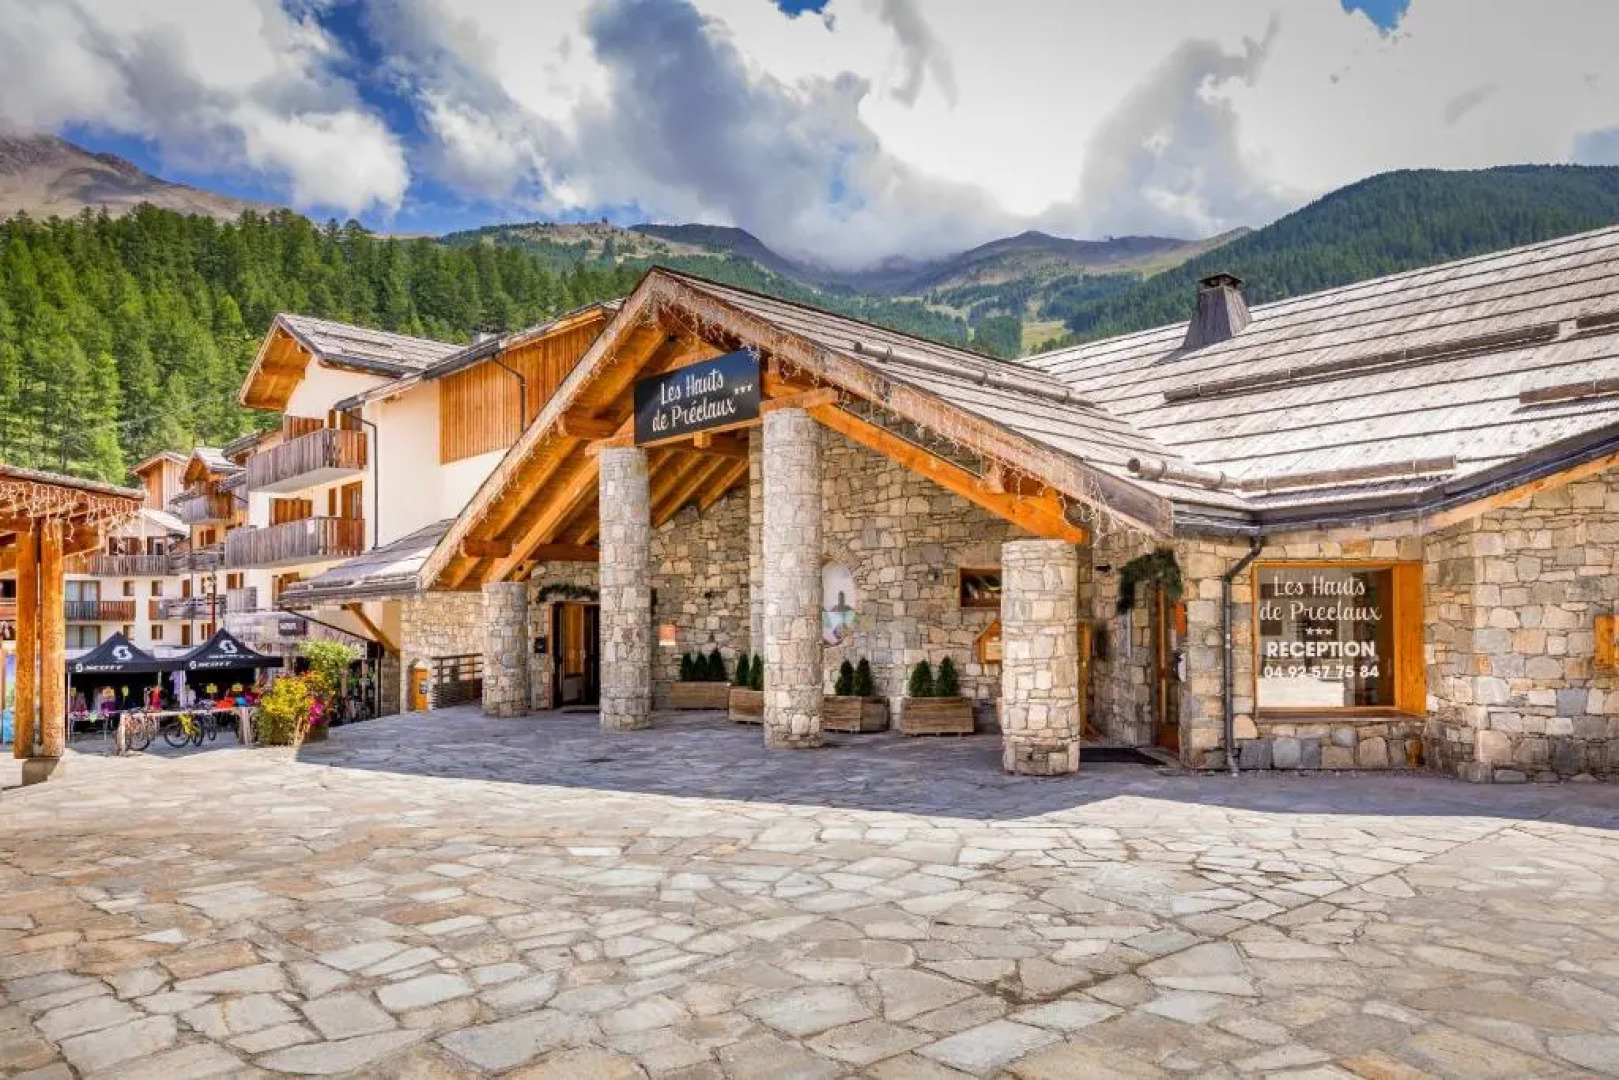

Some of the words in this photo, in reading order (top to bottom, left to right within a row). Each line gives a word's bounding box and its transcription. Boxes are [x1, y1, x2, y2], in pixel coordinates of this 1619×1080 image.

[661, 382, 681, 406] Les
[685, 368, 724, 398] Hauts
[652, 408, 669, 432] de
[1273, 575, 1304, 597] Les
[1312, 575, 1366, 596] Hauts
[1259, 600, 1284, 621] de
[1266, 641, 1376, 658] RECEPTION
[1264, 666, 1282, 678] 04
[1288, 666, 1307, 678] 92
[1311, 666, 1329, 678] 57
[1335, 666, 1355, 678] 75
[1359, 666, 1380, 678] 84
